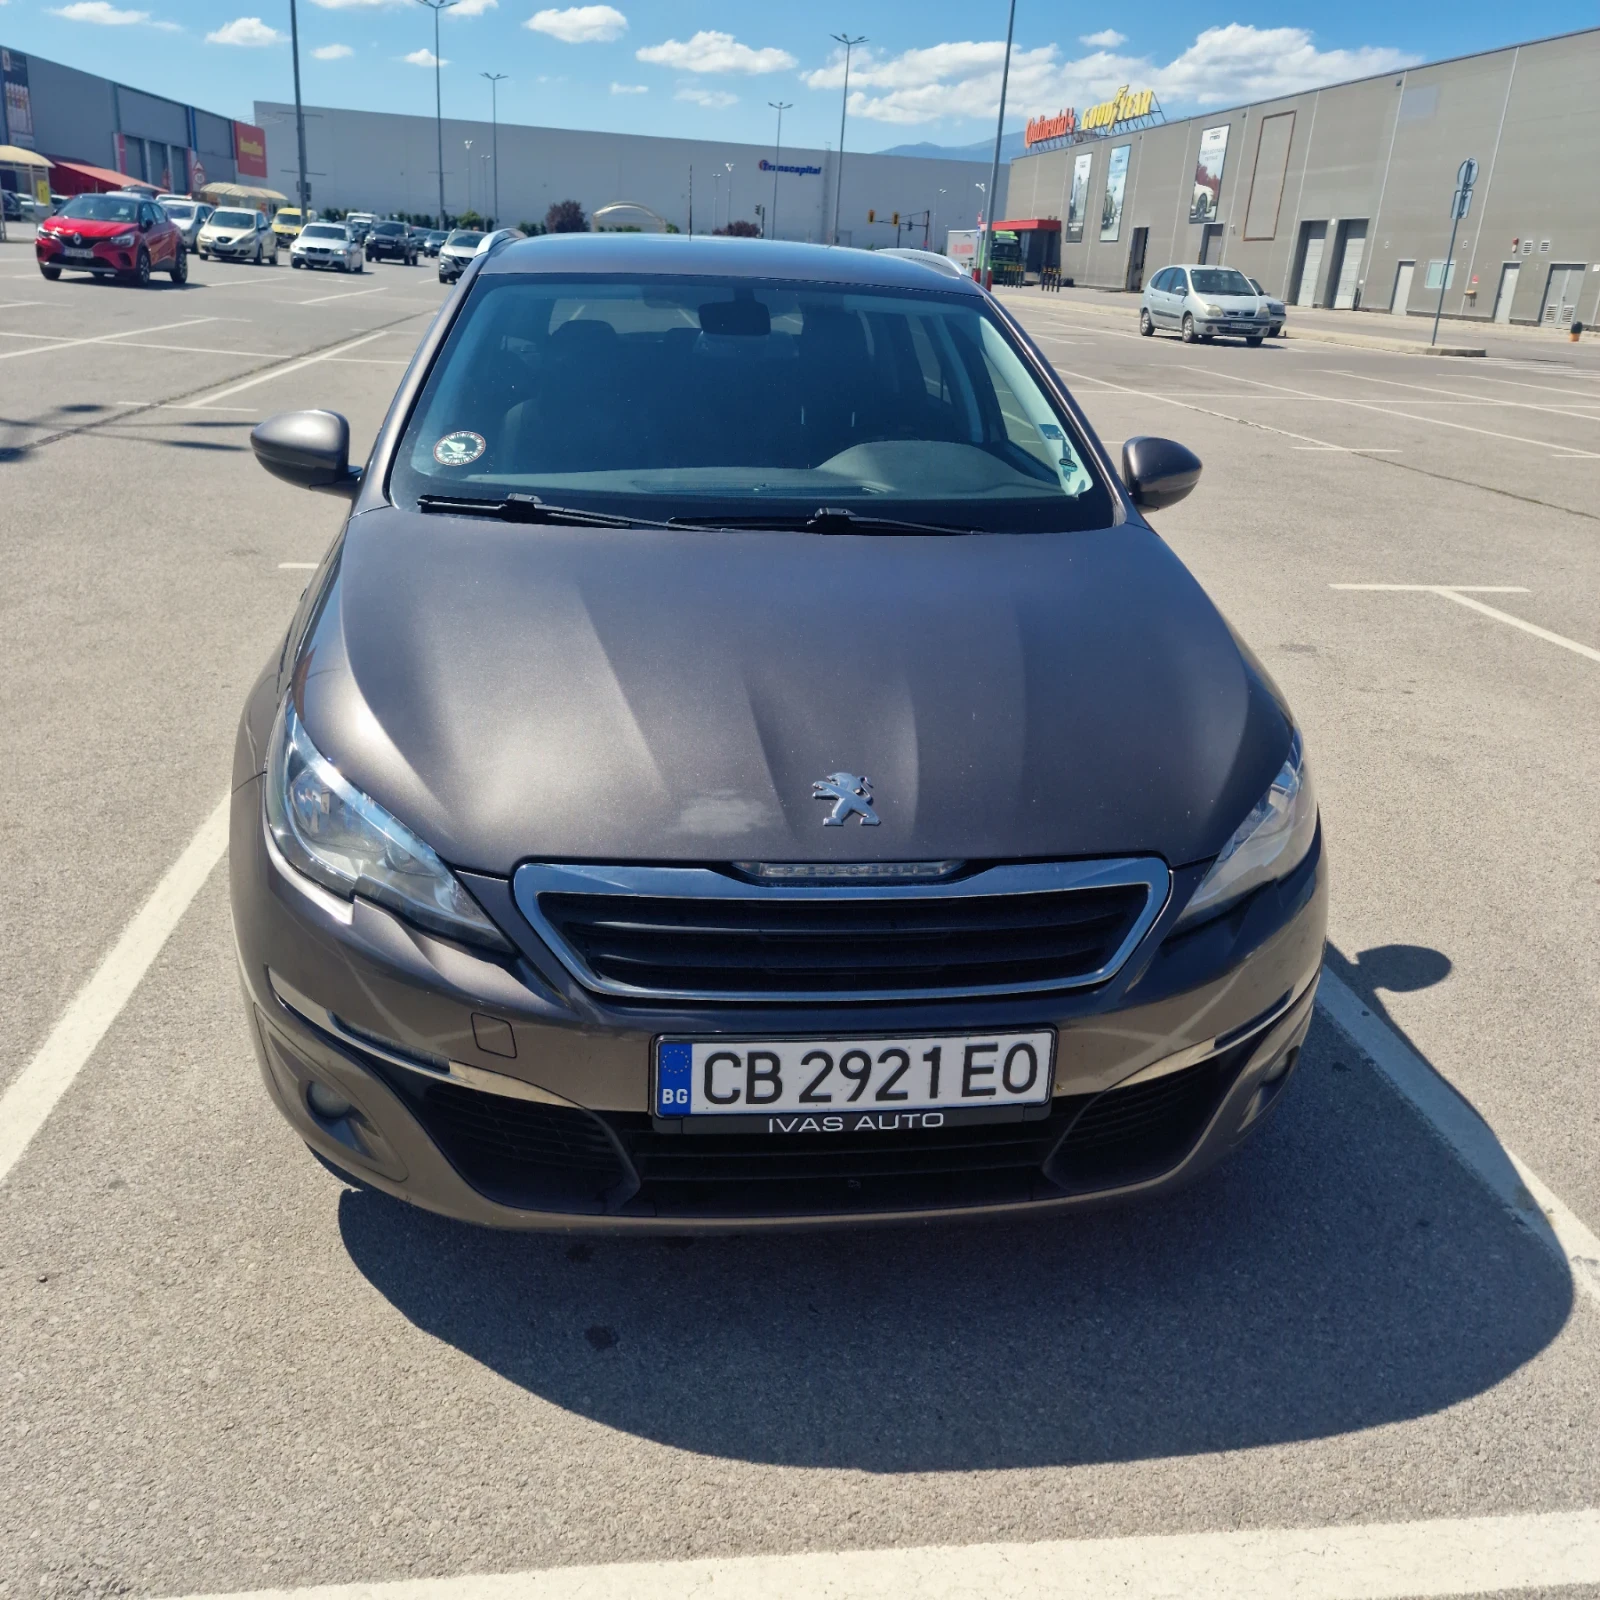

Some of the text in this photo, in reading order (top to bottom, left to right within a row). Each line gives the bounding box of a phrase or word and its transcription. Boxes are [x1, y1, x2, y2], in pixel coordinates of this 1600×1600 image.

[1081, 88, 1153, 131] GOODYEAR
[704, 1051, 783, 1105] CB
[798, 1044, 942, 1104] 2921
[662, 1088, 688, 1104] BG
[768, 1112, 944, 1133] IVAS AUTO
